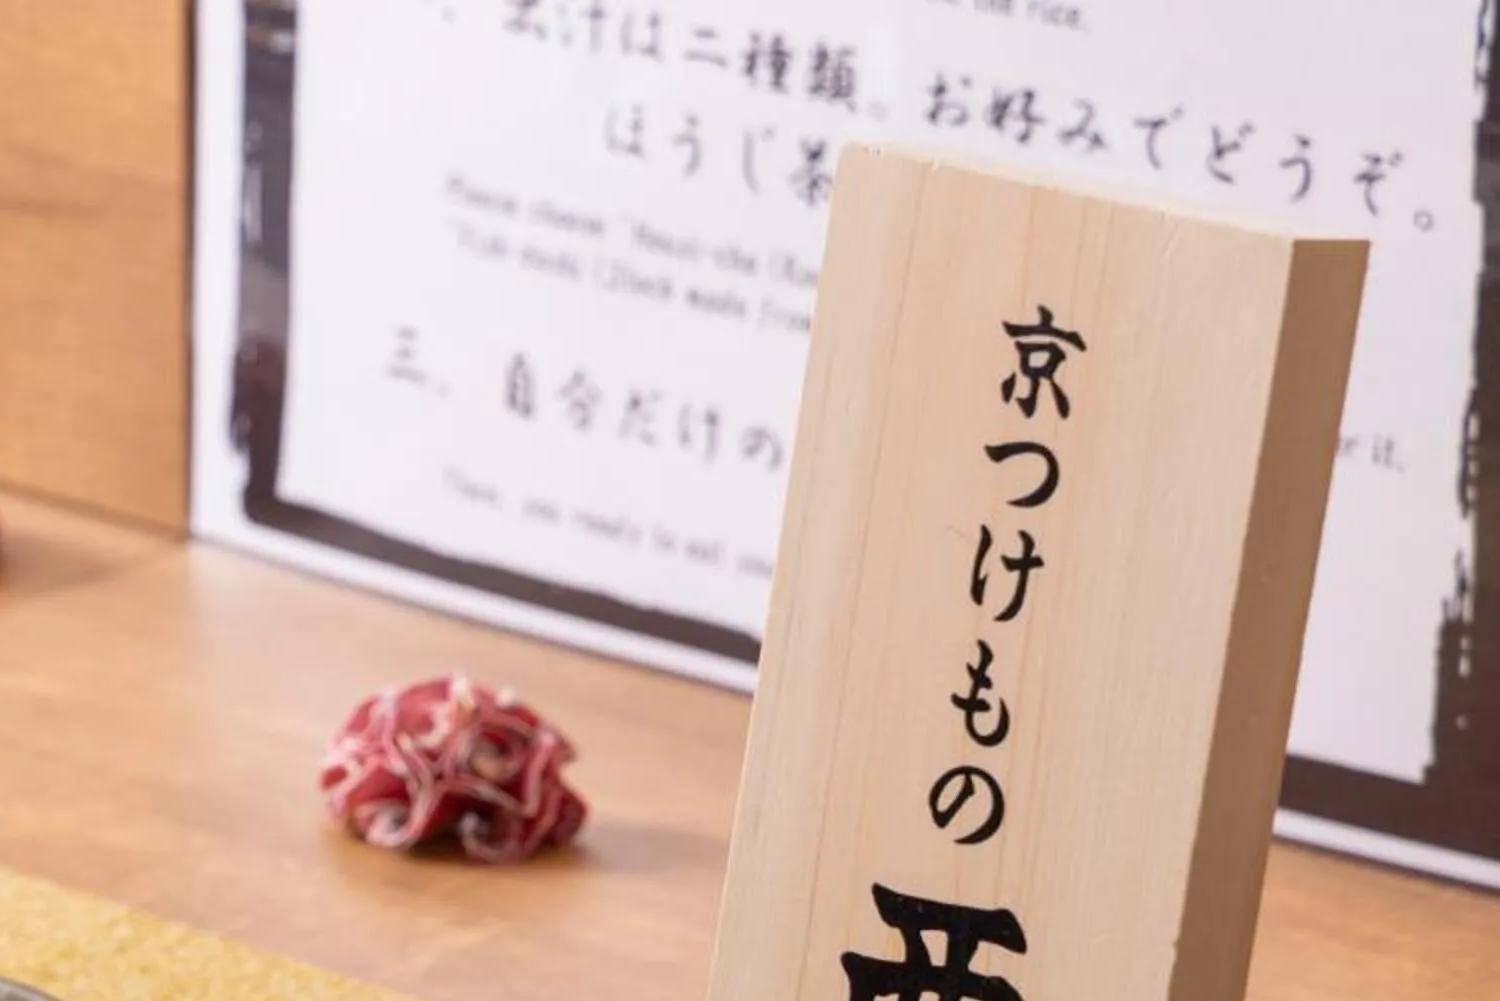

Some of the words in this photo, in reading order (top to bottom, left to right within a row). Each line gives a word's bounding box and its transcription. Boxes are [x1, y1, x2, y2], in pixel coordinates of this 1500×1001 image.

[928, 305, 1087, 845] 京つけもの
